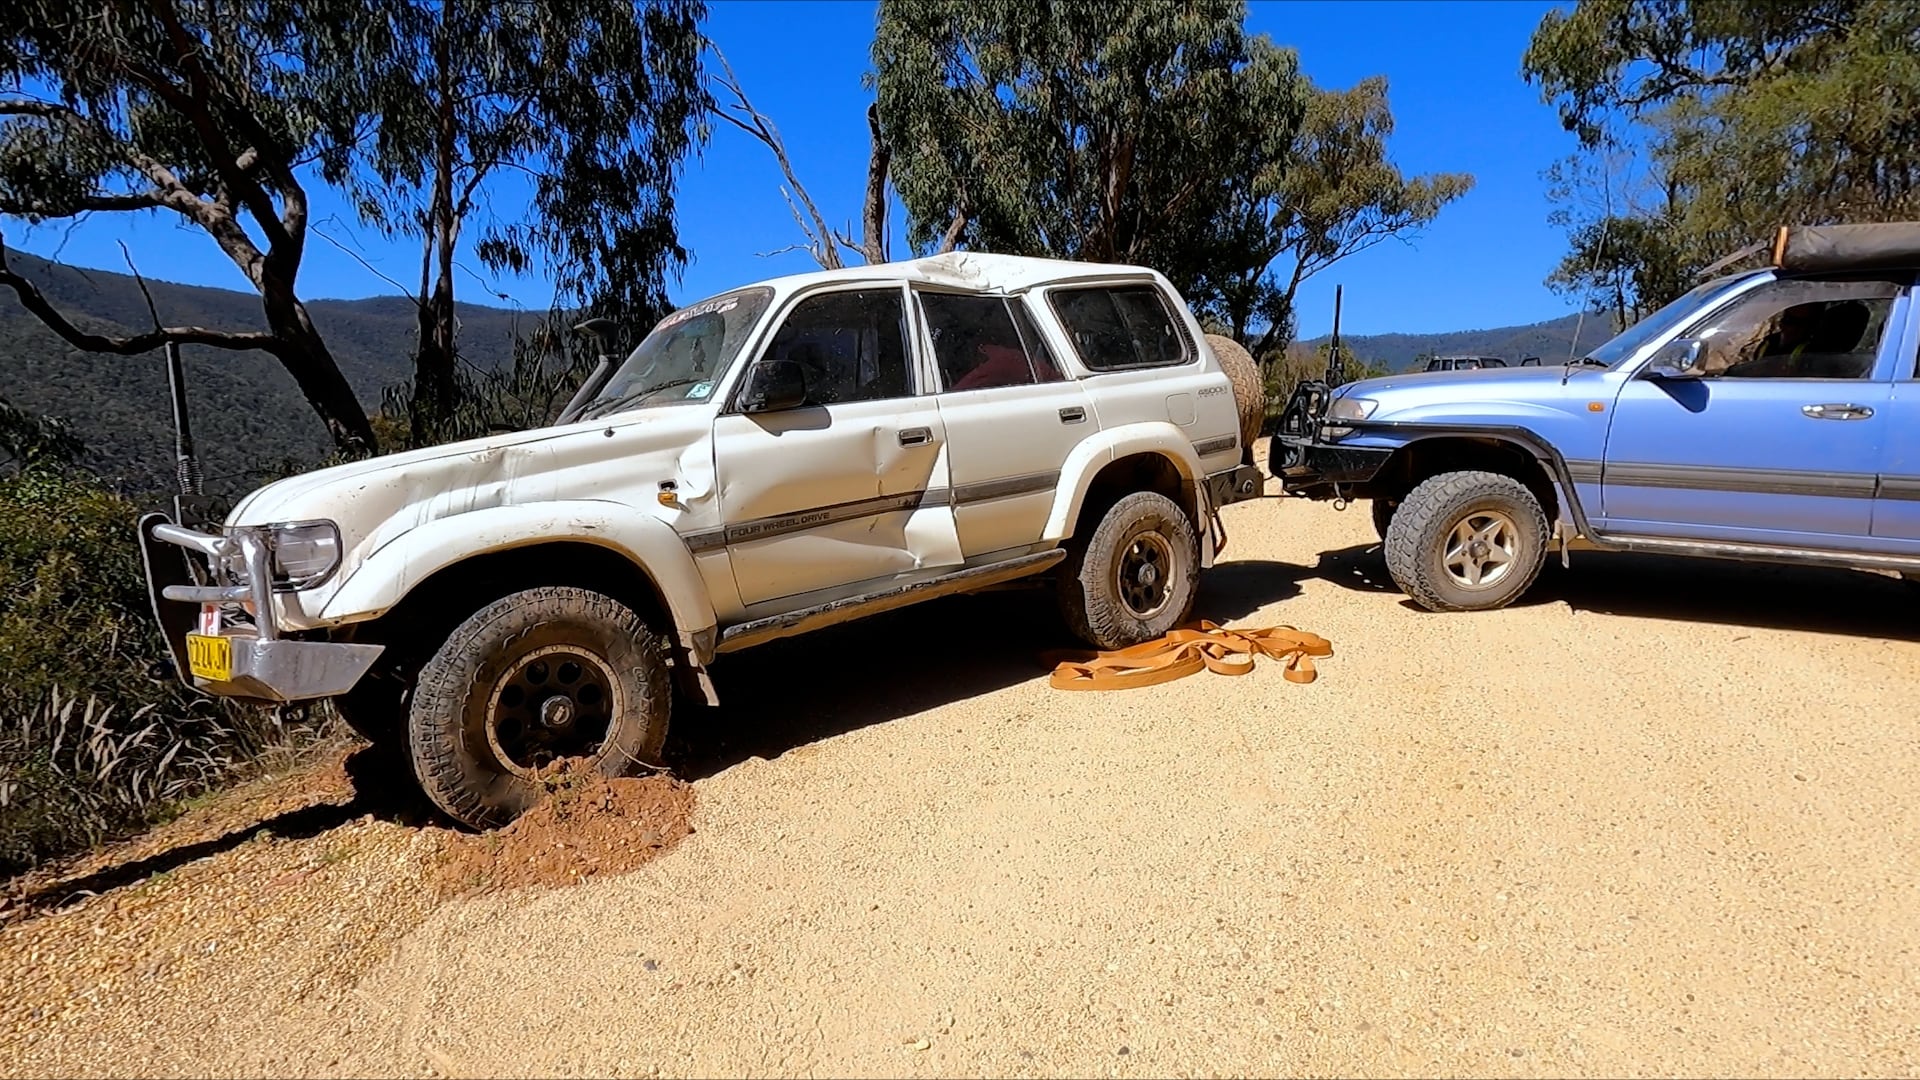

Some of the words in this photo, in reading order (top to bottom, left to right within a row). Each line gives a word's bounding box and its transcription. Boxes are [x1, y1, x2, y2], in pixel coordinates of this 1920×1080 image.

[730, 525, 761, 537] FOUR
[763, 518, 800, 531] WHEEL
[801, 512, 830, 523] DRIVE
